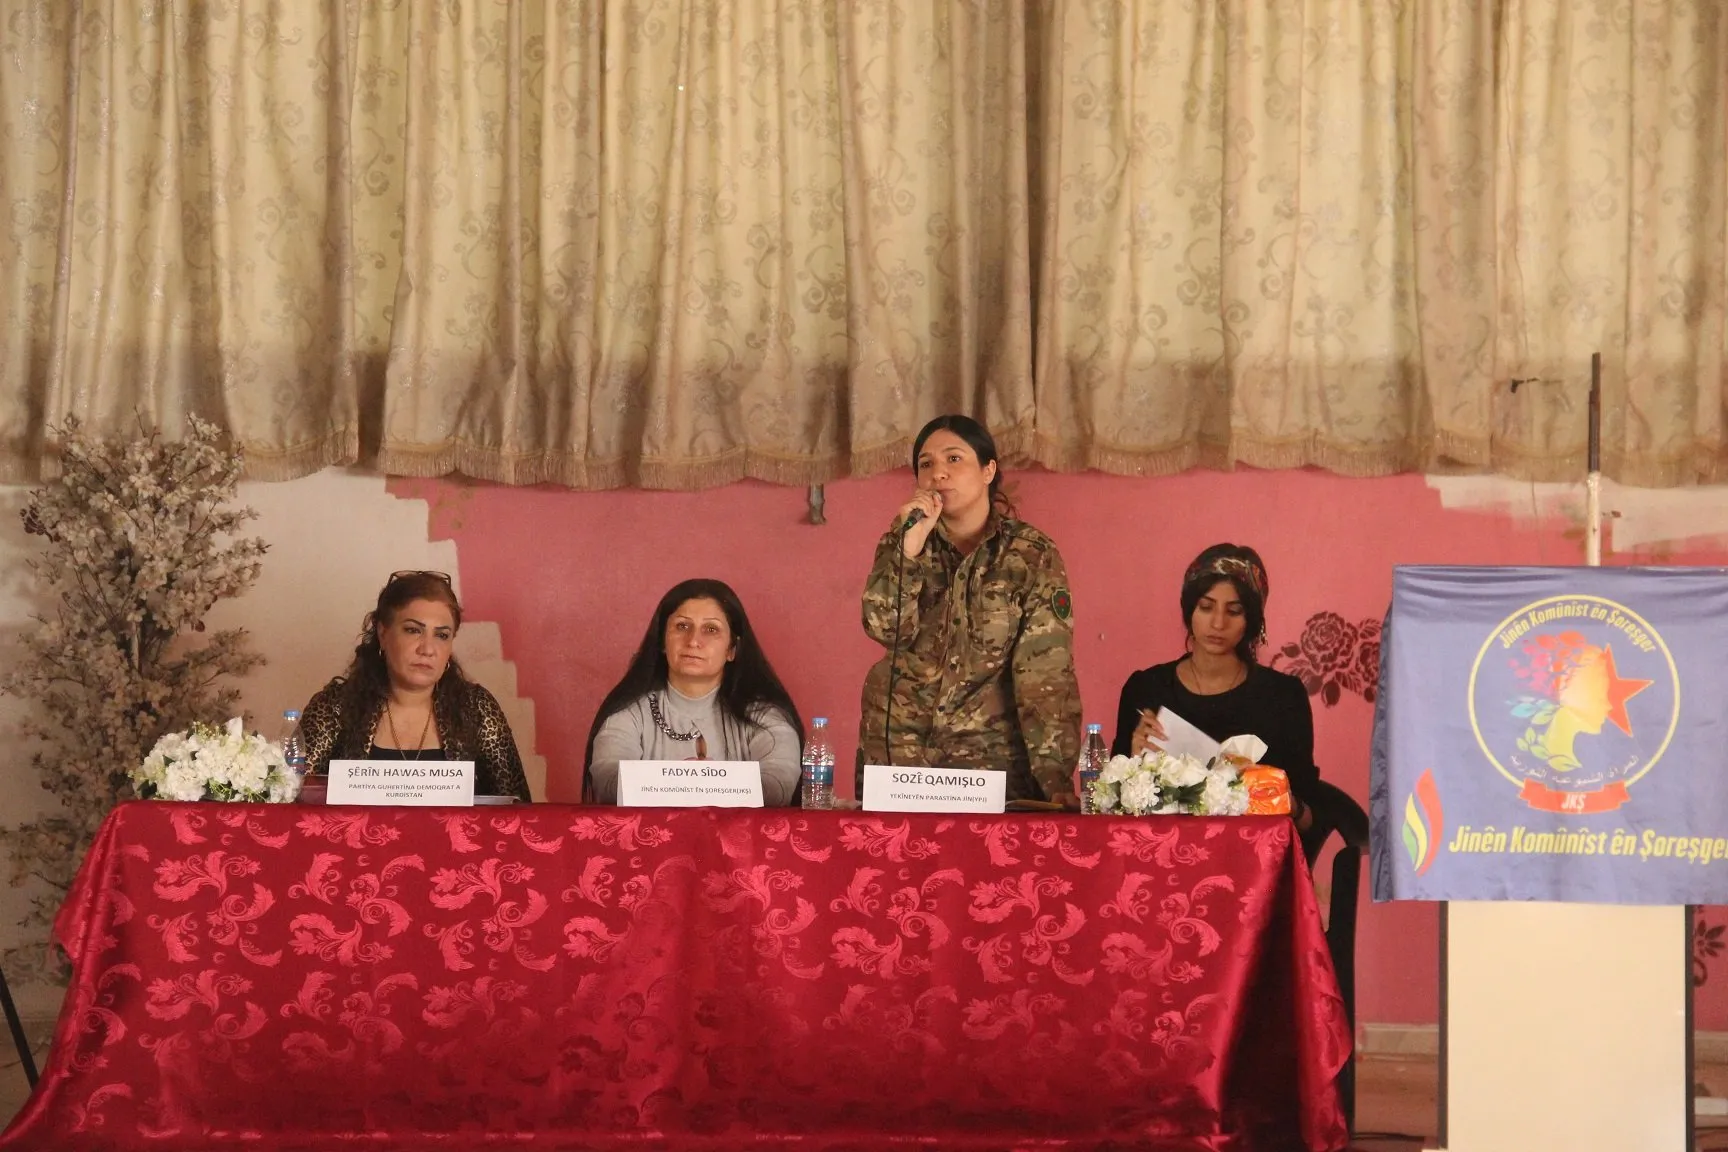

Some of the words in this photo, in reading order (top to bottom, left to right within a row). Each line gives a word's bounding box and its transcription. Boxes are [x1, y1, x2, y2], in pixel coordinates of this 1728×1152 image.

[383, 768, 426, 777] HAWAS
[429, 768, 463, 777] MUSA
[662, 767, 698, 777] FADYA
[701, 766, 727, 777] SÎDO
[892, 771, 923, 784] SOZÊ
[1561, 794, 1587, 814] JKŞ
[1449, 825, 1507, 853] Jinên
[1509, 825, 1608, 855] Komûnîst
[1610, 828, 1637, 855] ên
